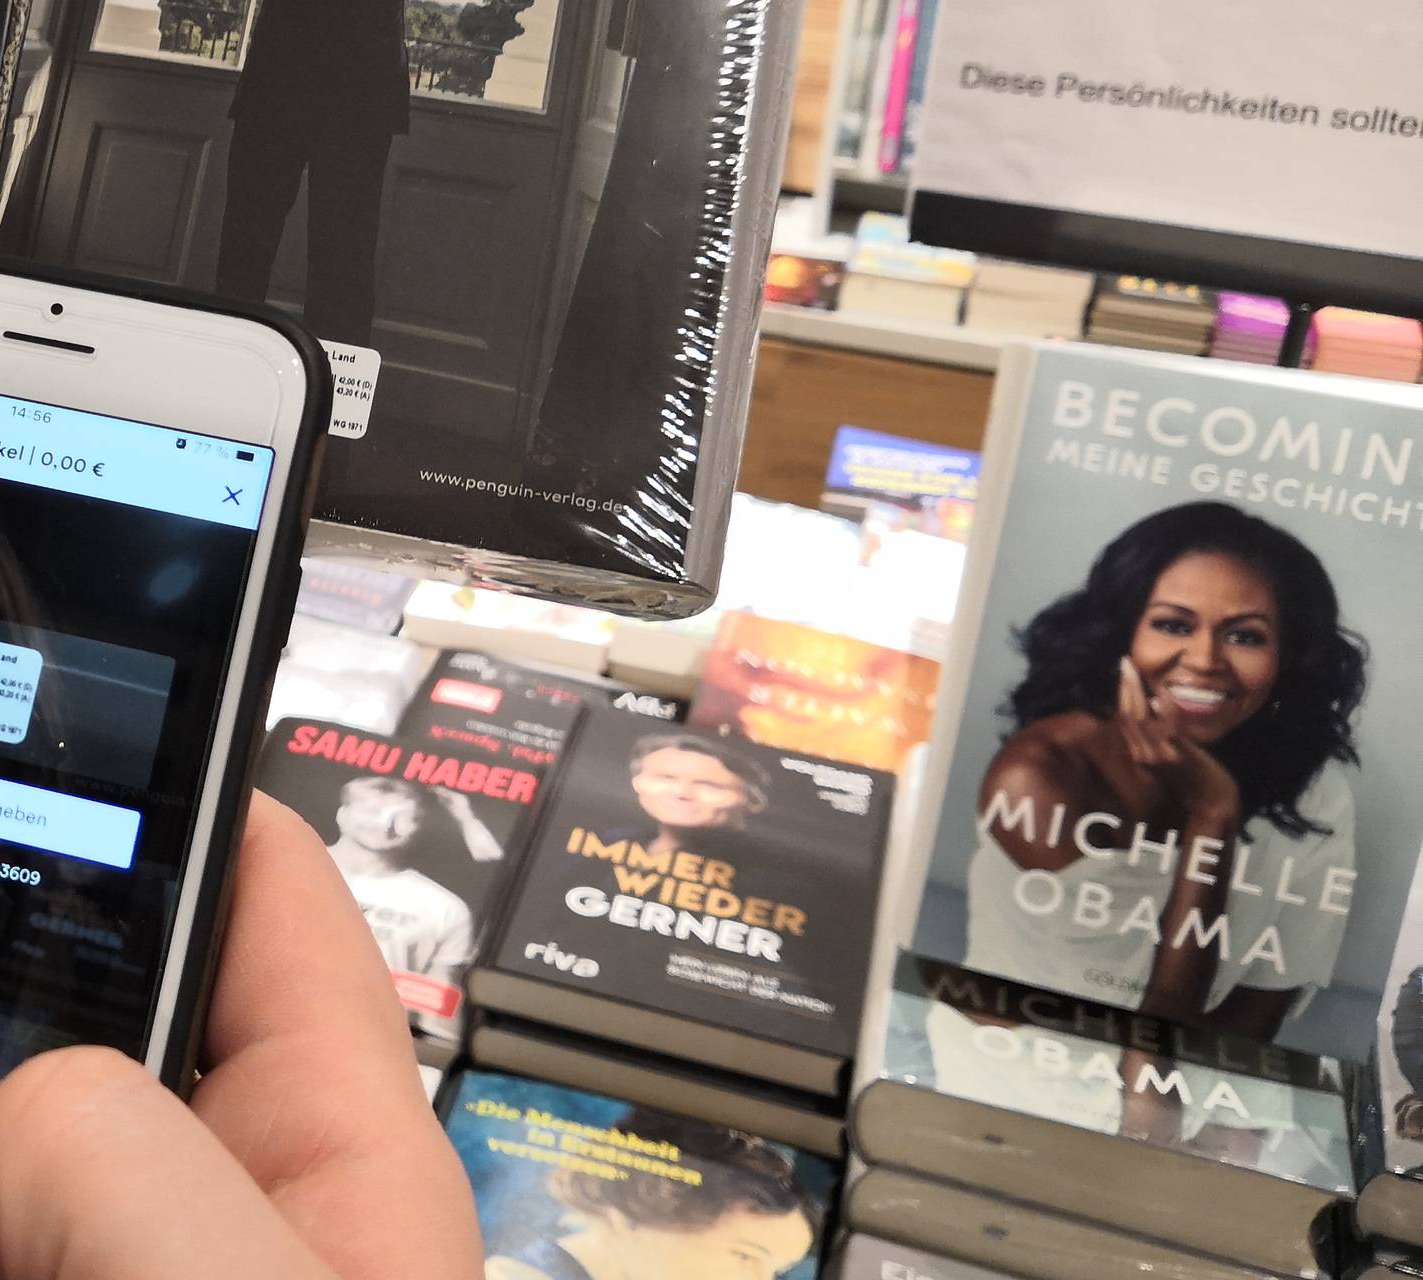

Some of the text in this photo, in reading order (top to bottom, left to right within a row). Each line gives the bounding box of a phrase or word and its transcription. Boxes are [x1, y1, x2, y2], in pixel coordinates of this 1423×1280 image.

[960, 62, 1046, 97] Diese
[1055, 71, 1319, 126] Persönlichkeiten
[332, 350, 355, 363] Land
[333, 419, 363, 432] WG 1971
[1053, 379, 1423, 486] BECOMIN
[41, 451, 86, 476] 0,00
[92, 461, 105, 478] €
[419, 468, 625, 514] www.penguin-verlag.de
[1045, 438, 1172, 485] MEINE
[287, 723, 402, 774] SAMU
[403, 751, 538, 805] HABER
[566, 826, 736, 889] IMMER
[978, 789, 1359, 915] MICHELLE
[564, 886, 783, 963] GERNER
[612, 865, 809, 936] WIEDER
[1014, 867, 1287, 974] OBAMA
[972, 1024, 1251, 1120] OBAMA
